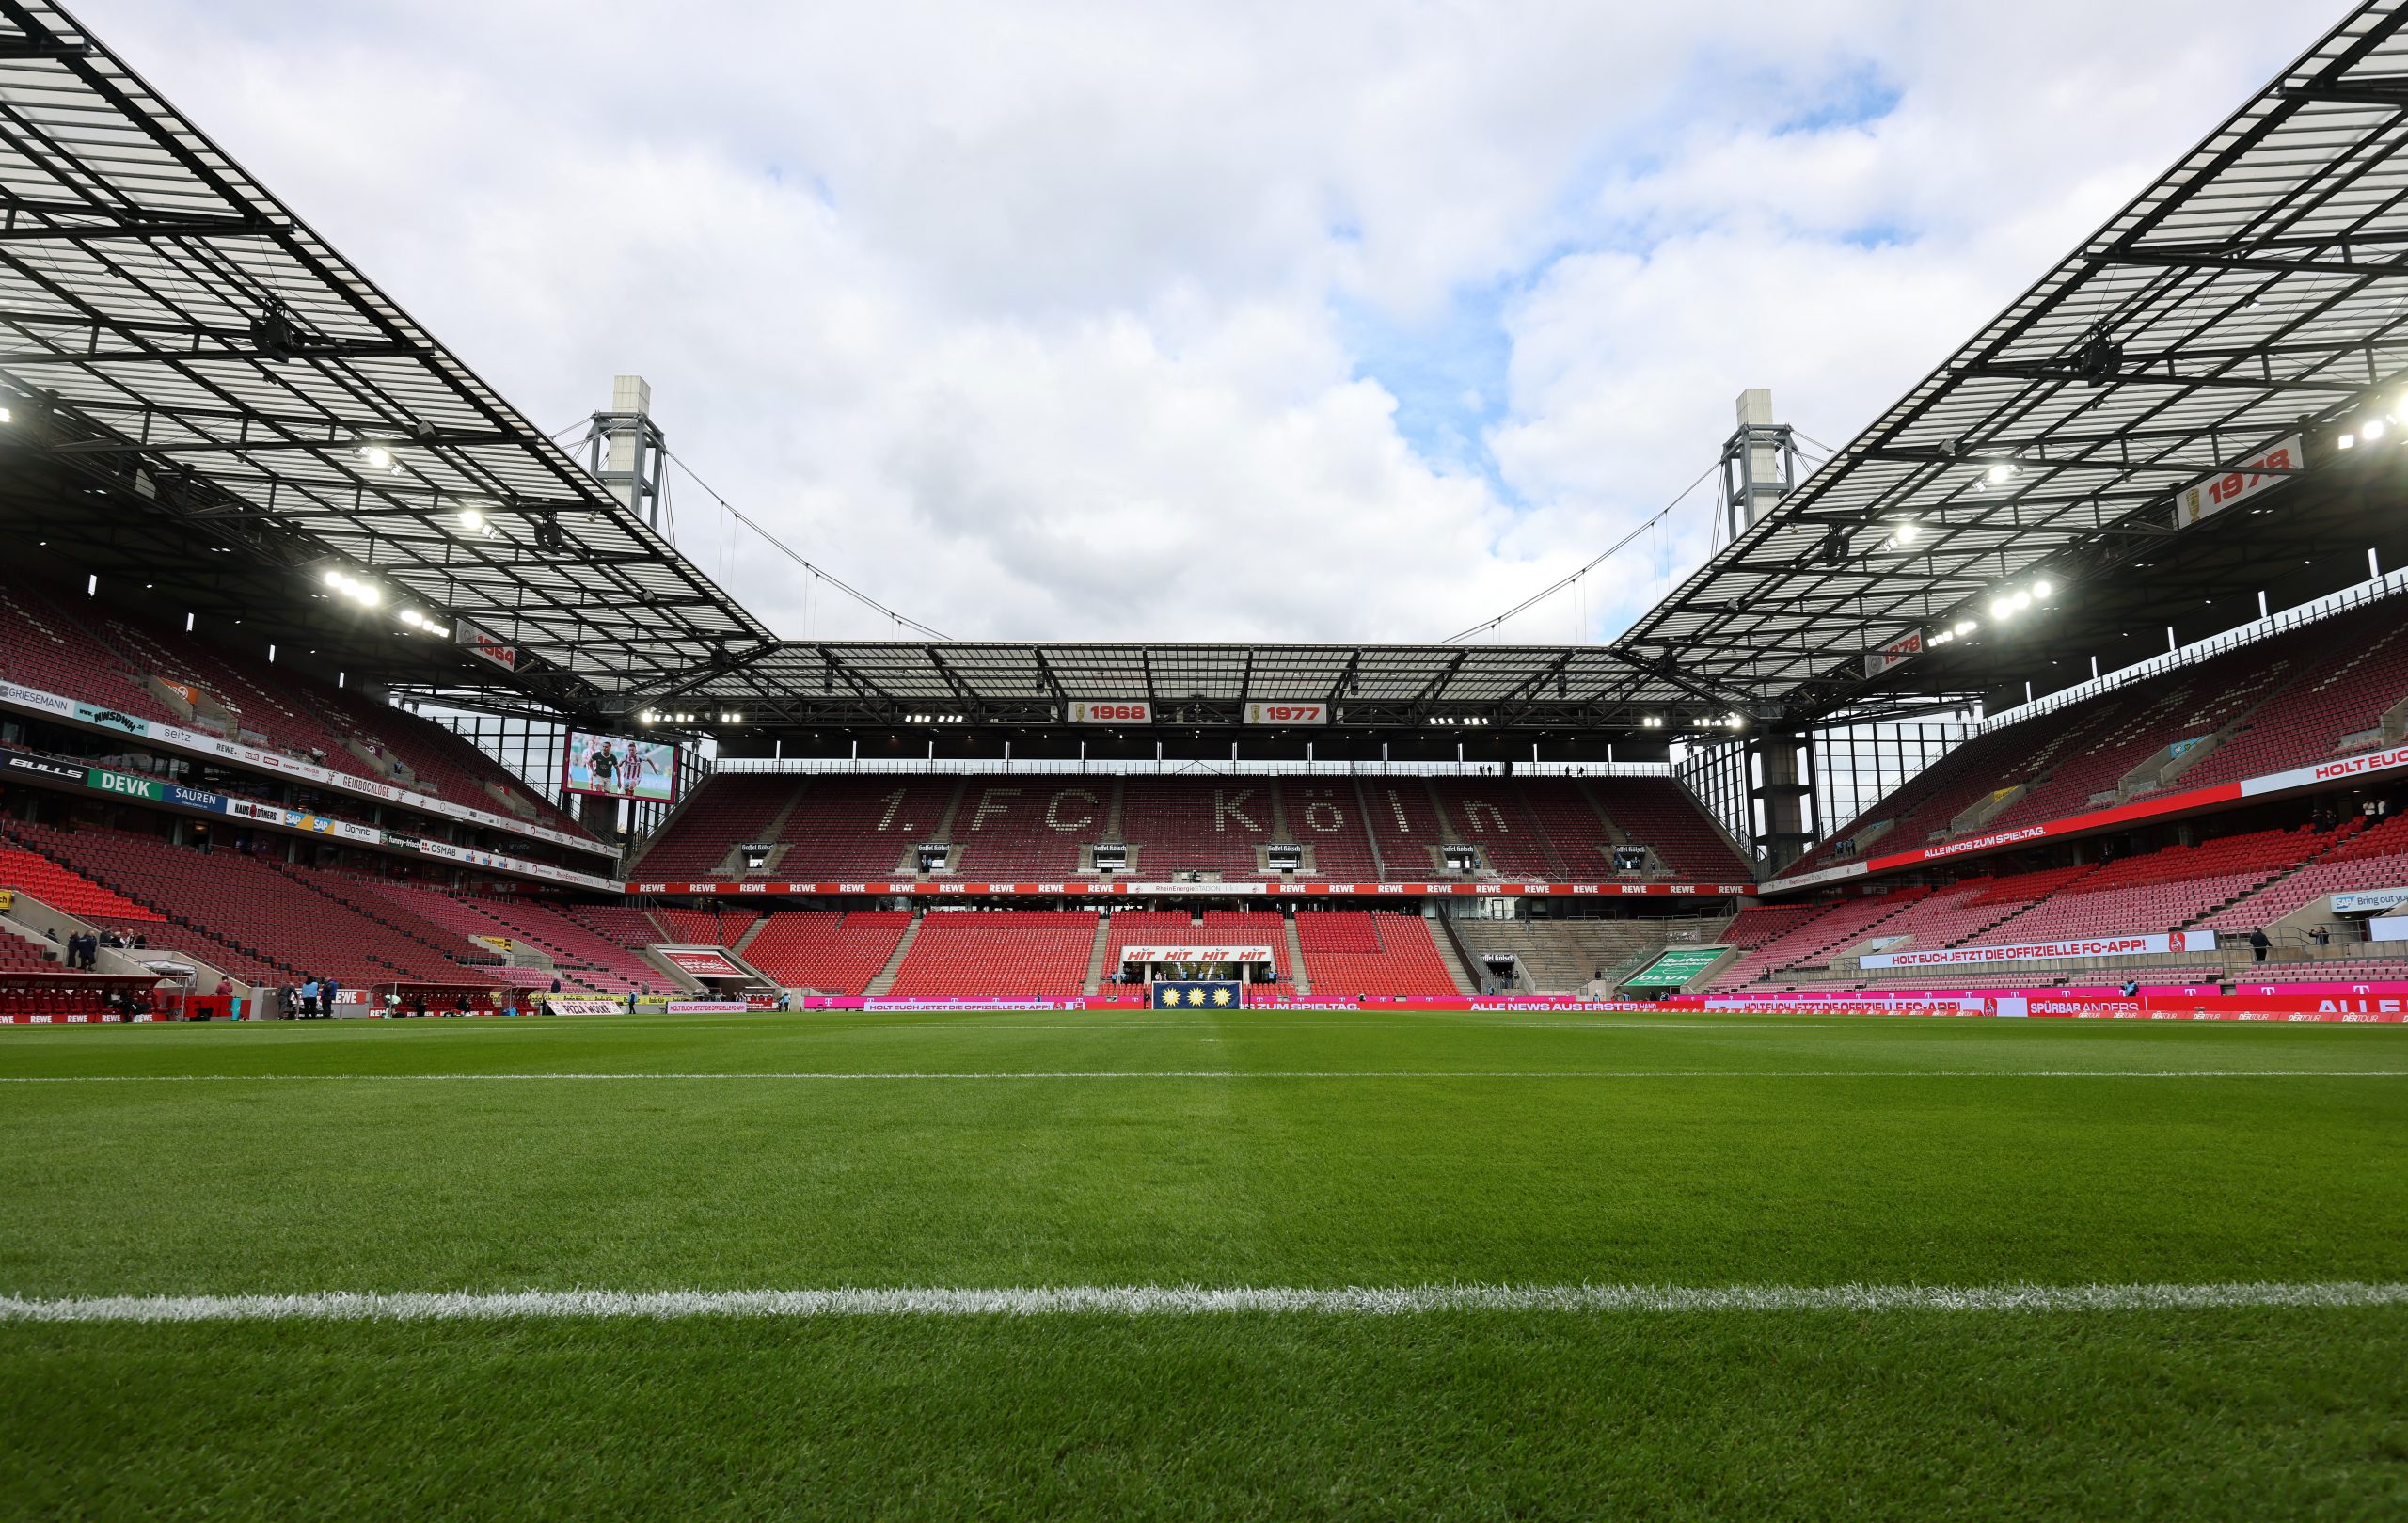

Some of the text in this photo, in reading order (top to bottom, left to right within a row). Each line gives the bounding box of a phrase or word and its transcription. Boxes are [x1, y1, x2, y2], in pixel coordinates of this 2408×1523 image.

[8, 688, 68, 710] GRIESEMANN
[1091, 706, 1146, 720] 1968
[1266, 706, 1321, 721] 1977
[164, 728, 192, 742] seitz
[9, 758, 84, 779] BULLS
[2315, 759, 2365, 779] HOLT
[102, 772, 150, 797] DEVK
[175, 788, 216, 805] SAUREN
[234, 803, 277, 820] HAUS DÖMERS
[285, 814, 301, 825] SAP
[313, 819, 329, 831] SAP
[388, 835, 420, 849] funny-frisch
[1925, 826, 2047, 858] ALLE INFOS ZUM SPIELTAG.
[431, 844, 456, 857] OSMAB
[640, 884, 666, 893] REWE
[690, 884, 716, 893] REWE
[739, 884, 766, 893] REWE
[790, 884, 816, 893] REWE
[840, 884, 865, 893] REWE
[890, 884, 915, 893] REWE
[940, 884, 965, 893] REWE
[990, 884, 1014, 893] REWE
[1038, 884, 1064, 893] REWE
[1088, 884, 1114, 893] REWE
[1525, 885, 1550, 894] REWE
[1573, 885, 1598, 894] REWE
[1622, 885, 1647, 894] REWE
[1671, 885, 1695, 894] REWE
[1719, 885, 1743, 894] REWE
[2357, 896, 2380, 906] Bring
[2380, 895, 2394, 903] out
[1893, 939, 2147, 965] HOLT EUCH JETZT DIE OFFIZIELLE FC-APP!
[335, 991, 357, 1004] EWE
[2030, 1001, 2081, 1014] SPÜRBAR
[2193, 1011, 2221, 1020] DERTOUR
[2238, 1011, 2269, 1020] DERTOUR
[2288, 1012, 2321, 1021] DERTOUR
[2342, 1012, 2379, 1022] DERTOUR
